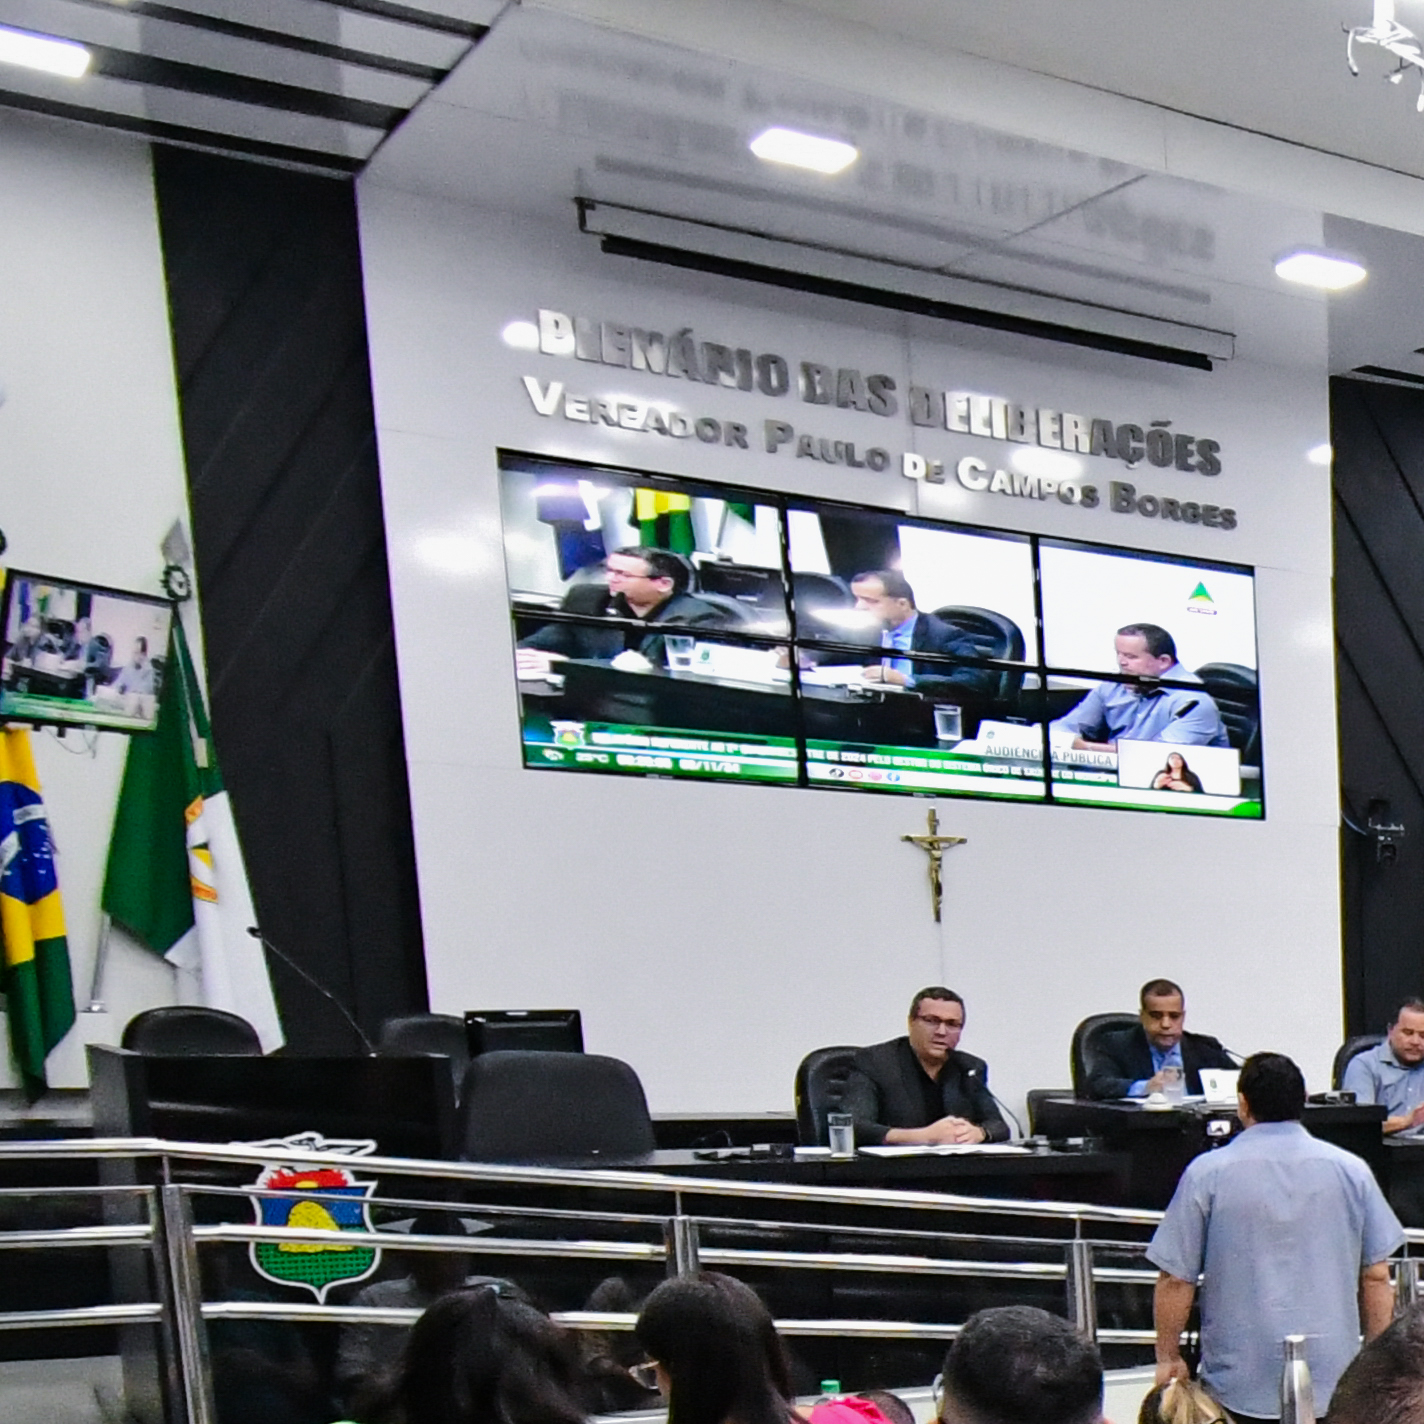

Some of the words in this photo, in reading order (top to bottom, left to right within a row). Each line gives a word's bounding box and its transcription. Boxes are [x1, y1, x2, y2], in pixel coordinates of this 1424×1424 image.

[521, 375, 749, 450] VEREADOR
[764, 419, 891, 472] PAULO
[902, 452, 945, 484] DE
[956, 456, 1100, 508] CAMPOS
[1109, 480, 1238, 531] BORGES
[538, 309, 789, 397] PLENÁRIO
[799, 360, 898, 417] DAS
[909, 386, 1222, 476] DELIBERAÇÕES
